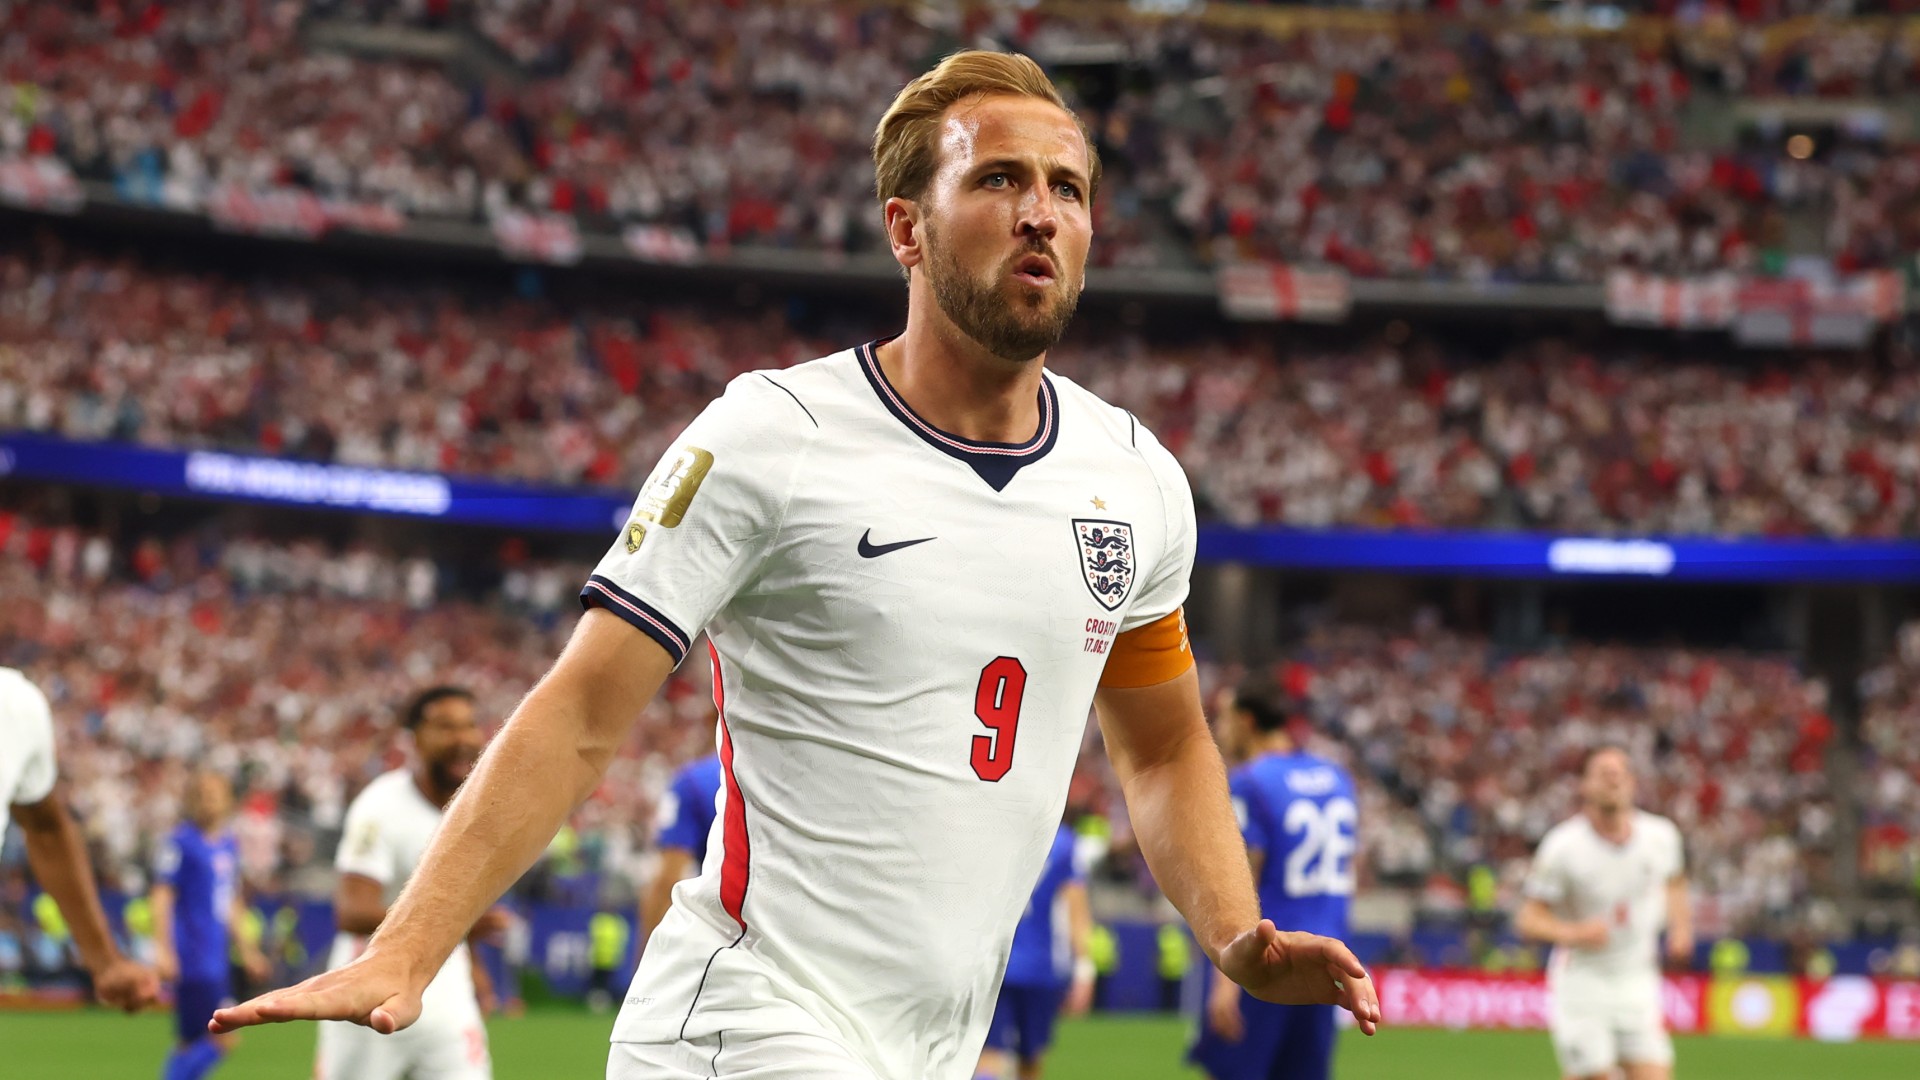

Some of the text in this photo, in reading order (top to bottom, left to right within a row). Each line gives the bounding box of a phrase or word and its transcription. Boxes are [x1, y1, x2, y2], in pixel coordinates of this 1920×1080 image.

[1085, 618, 1117, 636] CROATI
[969, 655, 1027, 783] 9
[1284, 798, 1358, 897] 26
